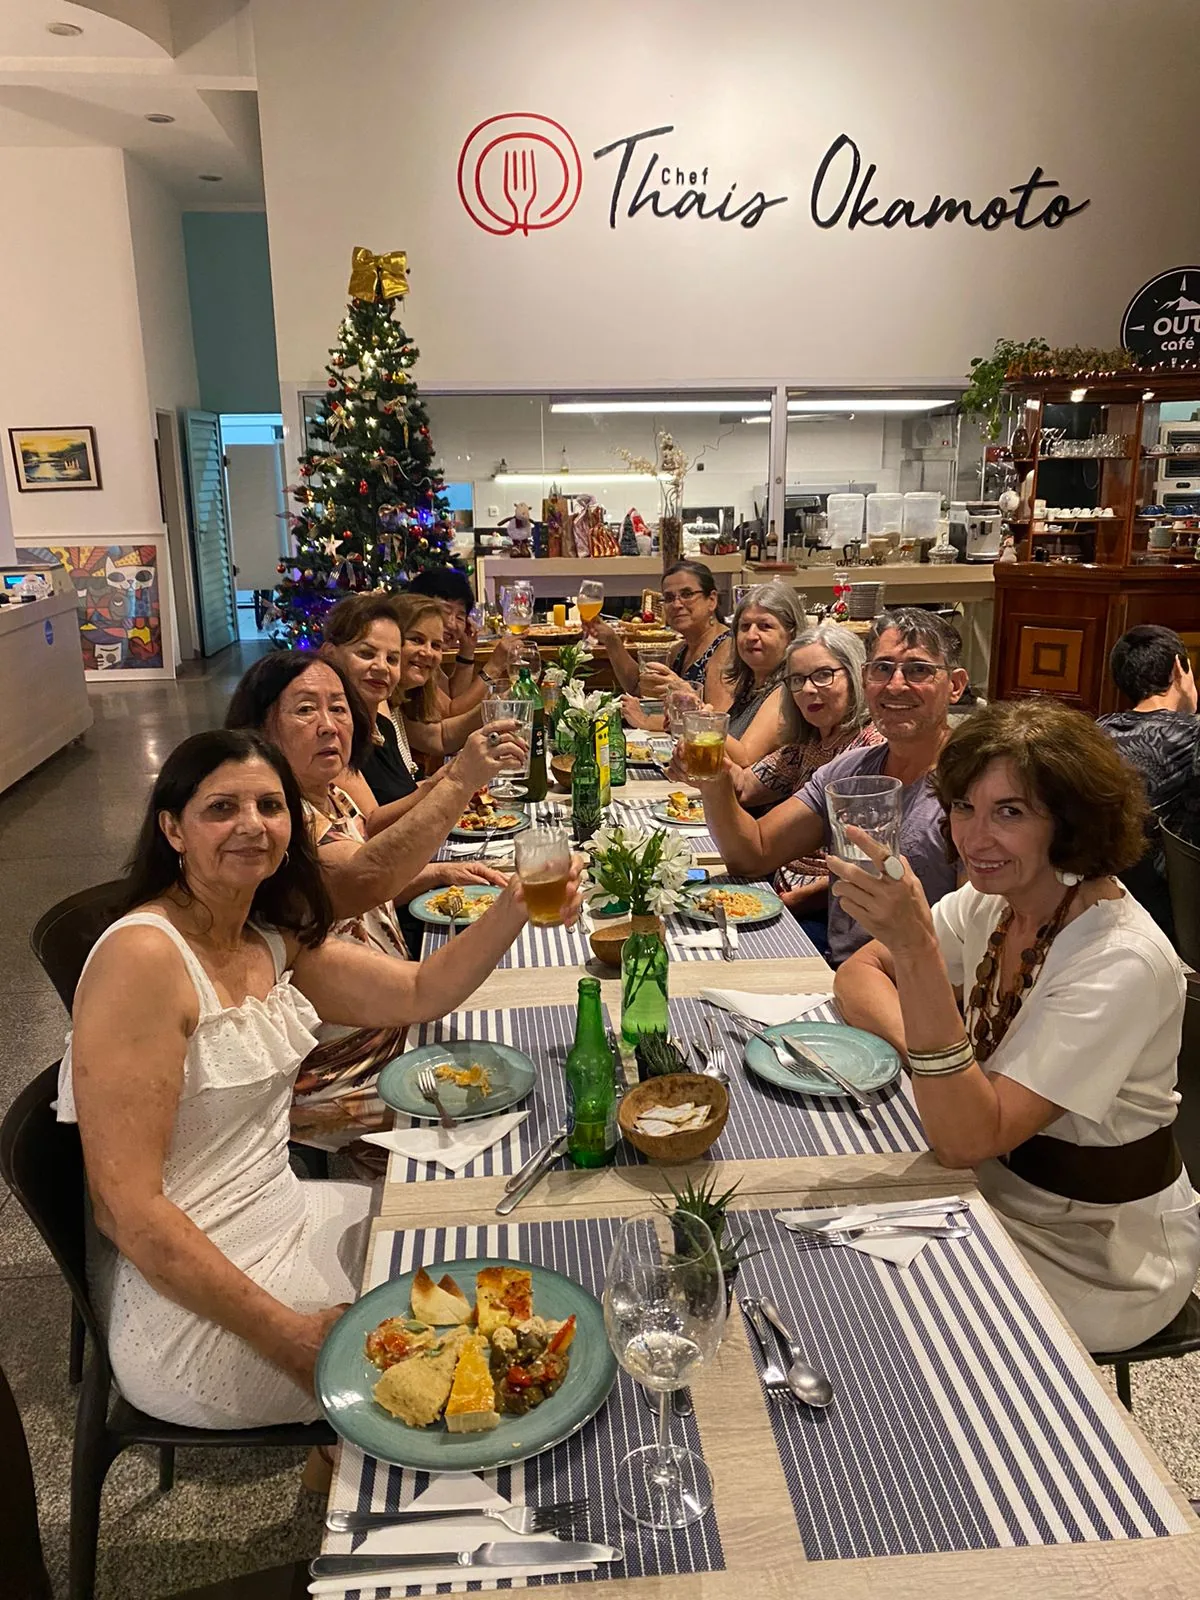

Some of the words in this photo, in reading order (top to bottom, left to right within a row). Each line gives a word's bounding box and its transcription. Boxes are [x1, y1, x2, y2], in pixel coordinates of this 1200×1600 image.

[661, 167, 708, 185] Chef
[809, 132, 1092, 231] Okamoto
[1160, 336, 1195, 350] café
